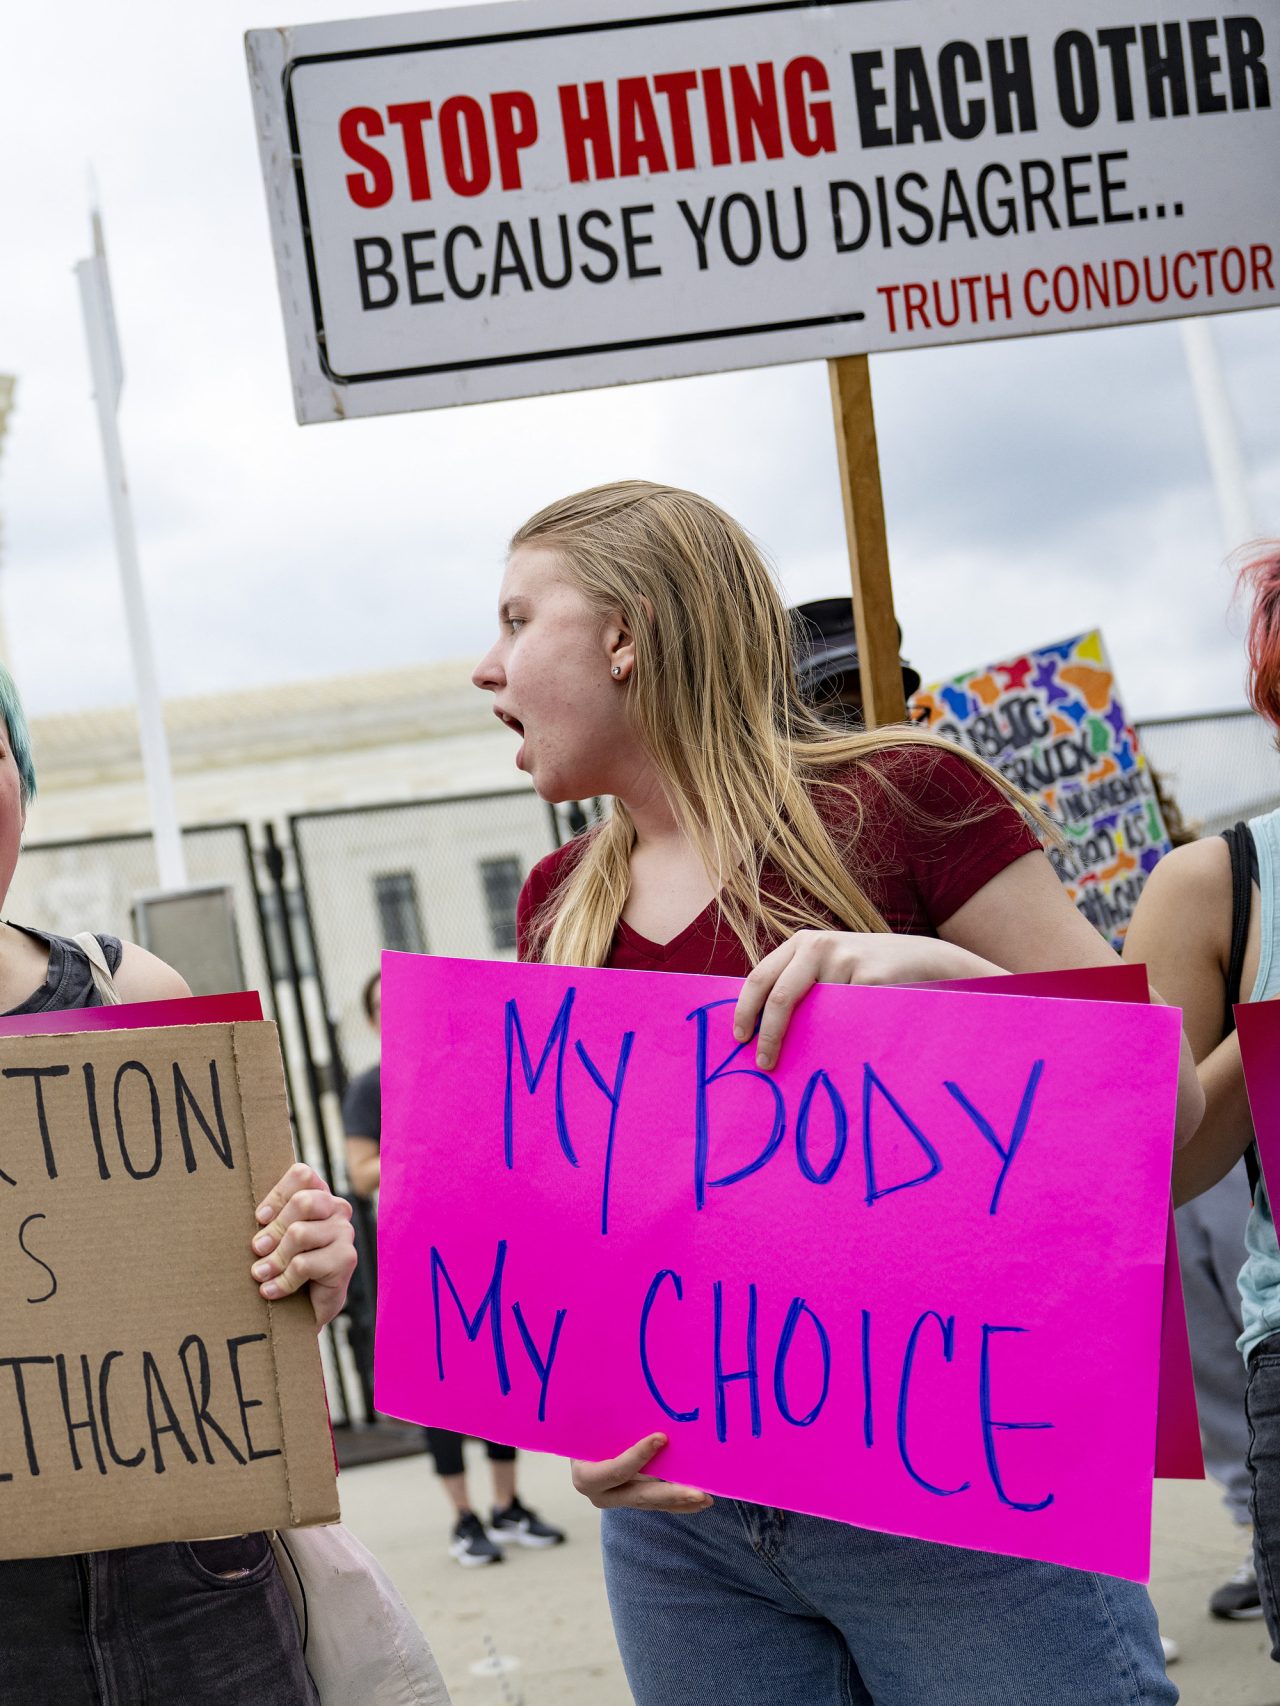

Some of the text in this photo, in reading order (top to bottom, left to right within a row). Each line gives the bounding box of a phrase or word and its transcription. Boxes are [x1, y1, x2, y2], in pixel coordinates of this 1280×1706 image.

[338, 15, 1272, 209] STOP HATING EACH OTHER
[353, 150, 1184, 312] BECAUSE YOU DISAGREE...
[877, 245, 1274, 332] TRUTH CONDUCTOR
[936, 697, 1051, 758] BLIC
[686, 998, 1044, 1216] BODY
[639, 1269, 1055, 1513] CHOICE
